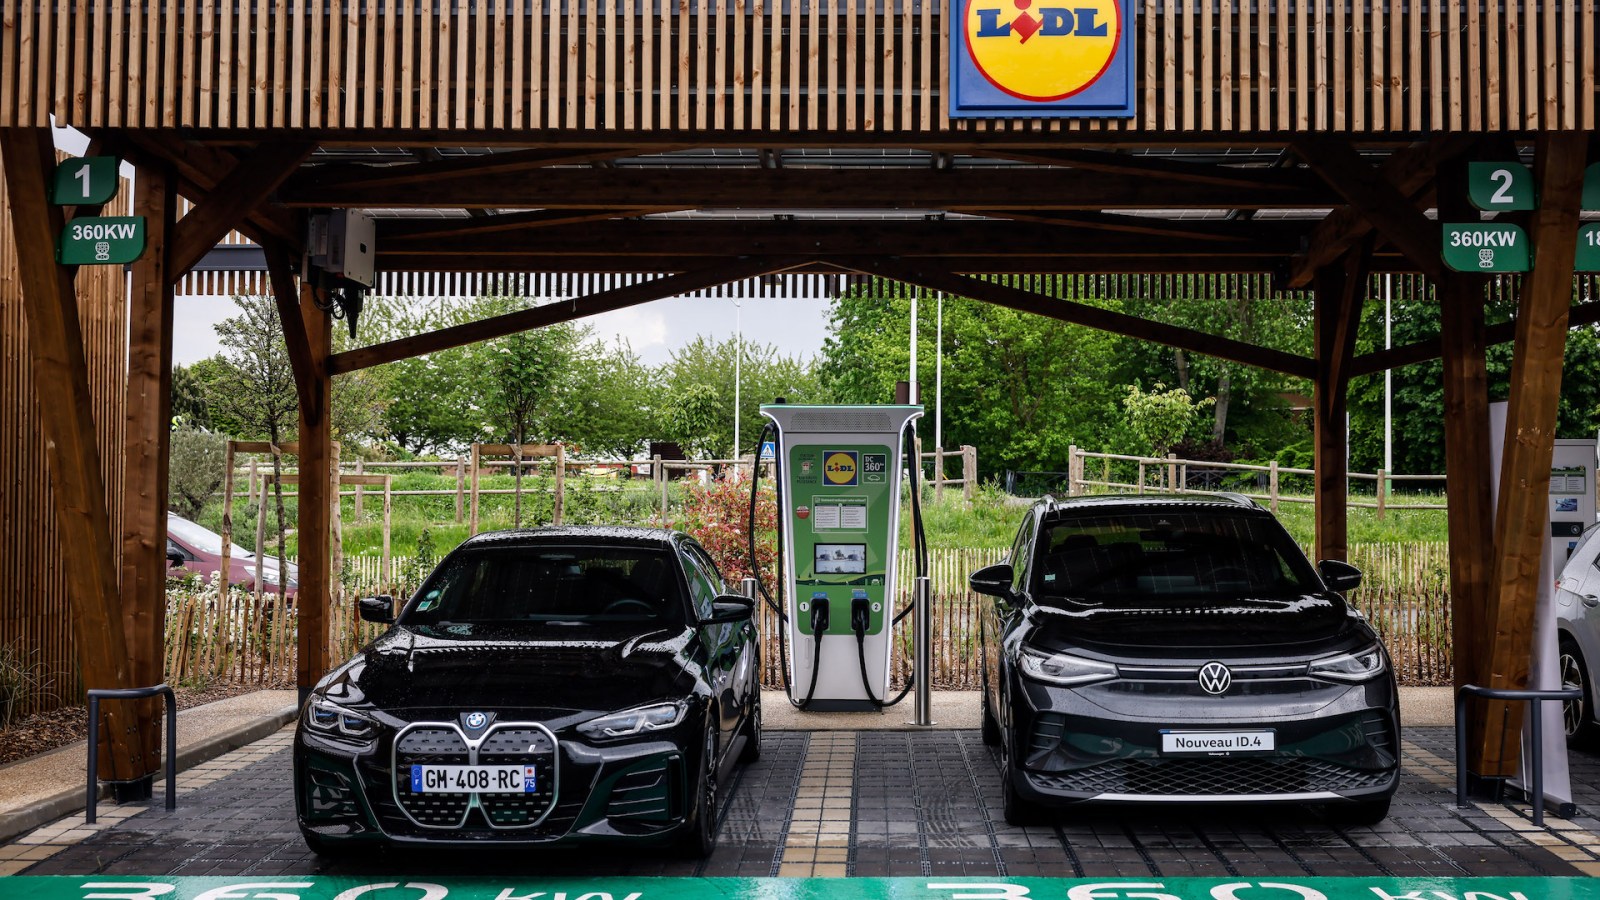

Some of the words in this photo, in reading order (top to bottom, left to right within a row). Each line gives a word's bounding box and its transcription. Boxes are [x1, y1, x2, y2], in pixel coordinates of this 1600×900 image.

[74, 164, 91, 198] 1
[1490, 169, 1514, 204] 2
[72, 223, 136, 240] 360KW
[1450, 231, 1517, 247] 360KW
[1175, 737, 1232, 748] Nouveau
[1236, 736, 1262, 747] ID.4
[425, 769, 520, 789] GM-408-RC
[525, 778, 536, 788] 75
